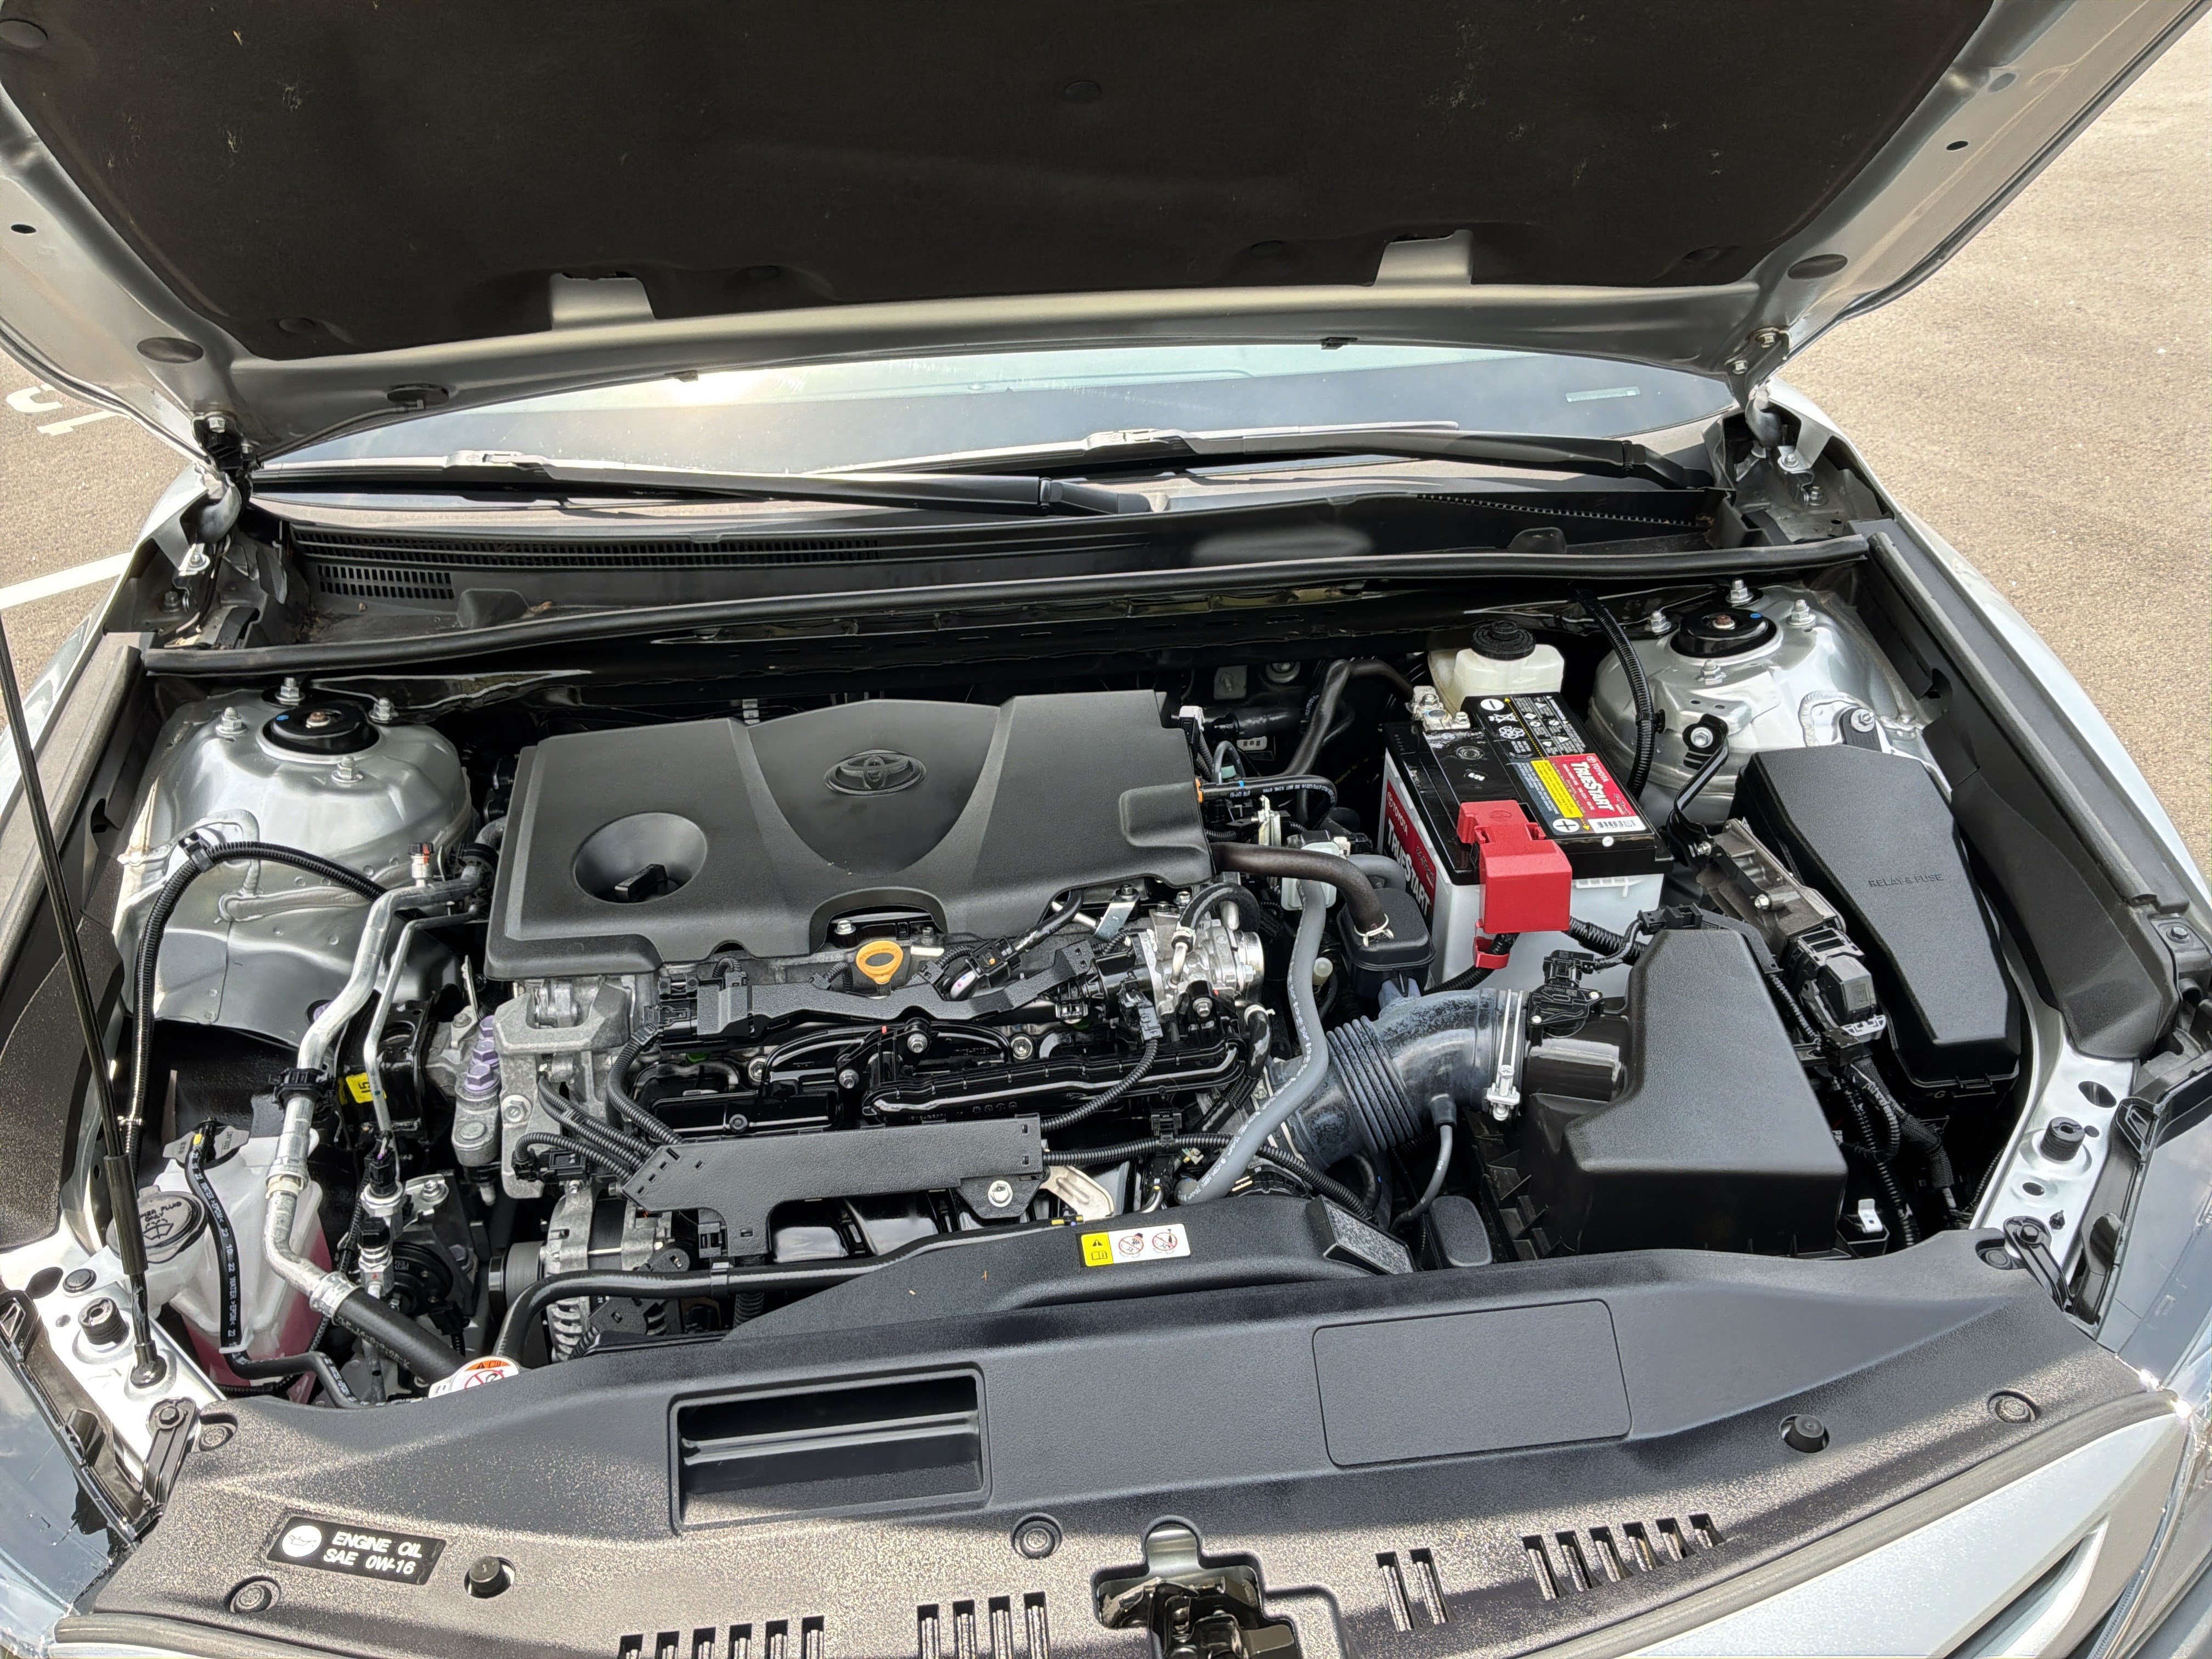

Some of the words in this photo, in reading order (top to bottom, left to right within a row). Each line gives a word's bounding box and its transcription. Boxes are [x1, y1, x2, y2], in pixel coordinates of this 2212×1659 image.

[1592, 762, 1610, 783] TOYOTA
[1571, 761, 1614, 811] TRUESTART
[1392, 803, 1408, 837] TOYOTA
[1387, 820, 1431, 917] TRUESTART
[1869, 878, 1903, 887] RELAY
[1914, 874, 1944, 883] FUSE
[228, 1262, 235, 1273] 22
[228, 1329, 236, 1338] 22
[331, 1531, 392, 1553] ENGINE
[398, 1541, 422, 1558] OIL
[323, 1549, 359, 1566] SAE
[365, 1555, 416, 1575] 0W-16
